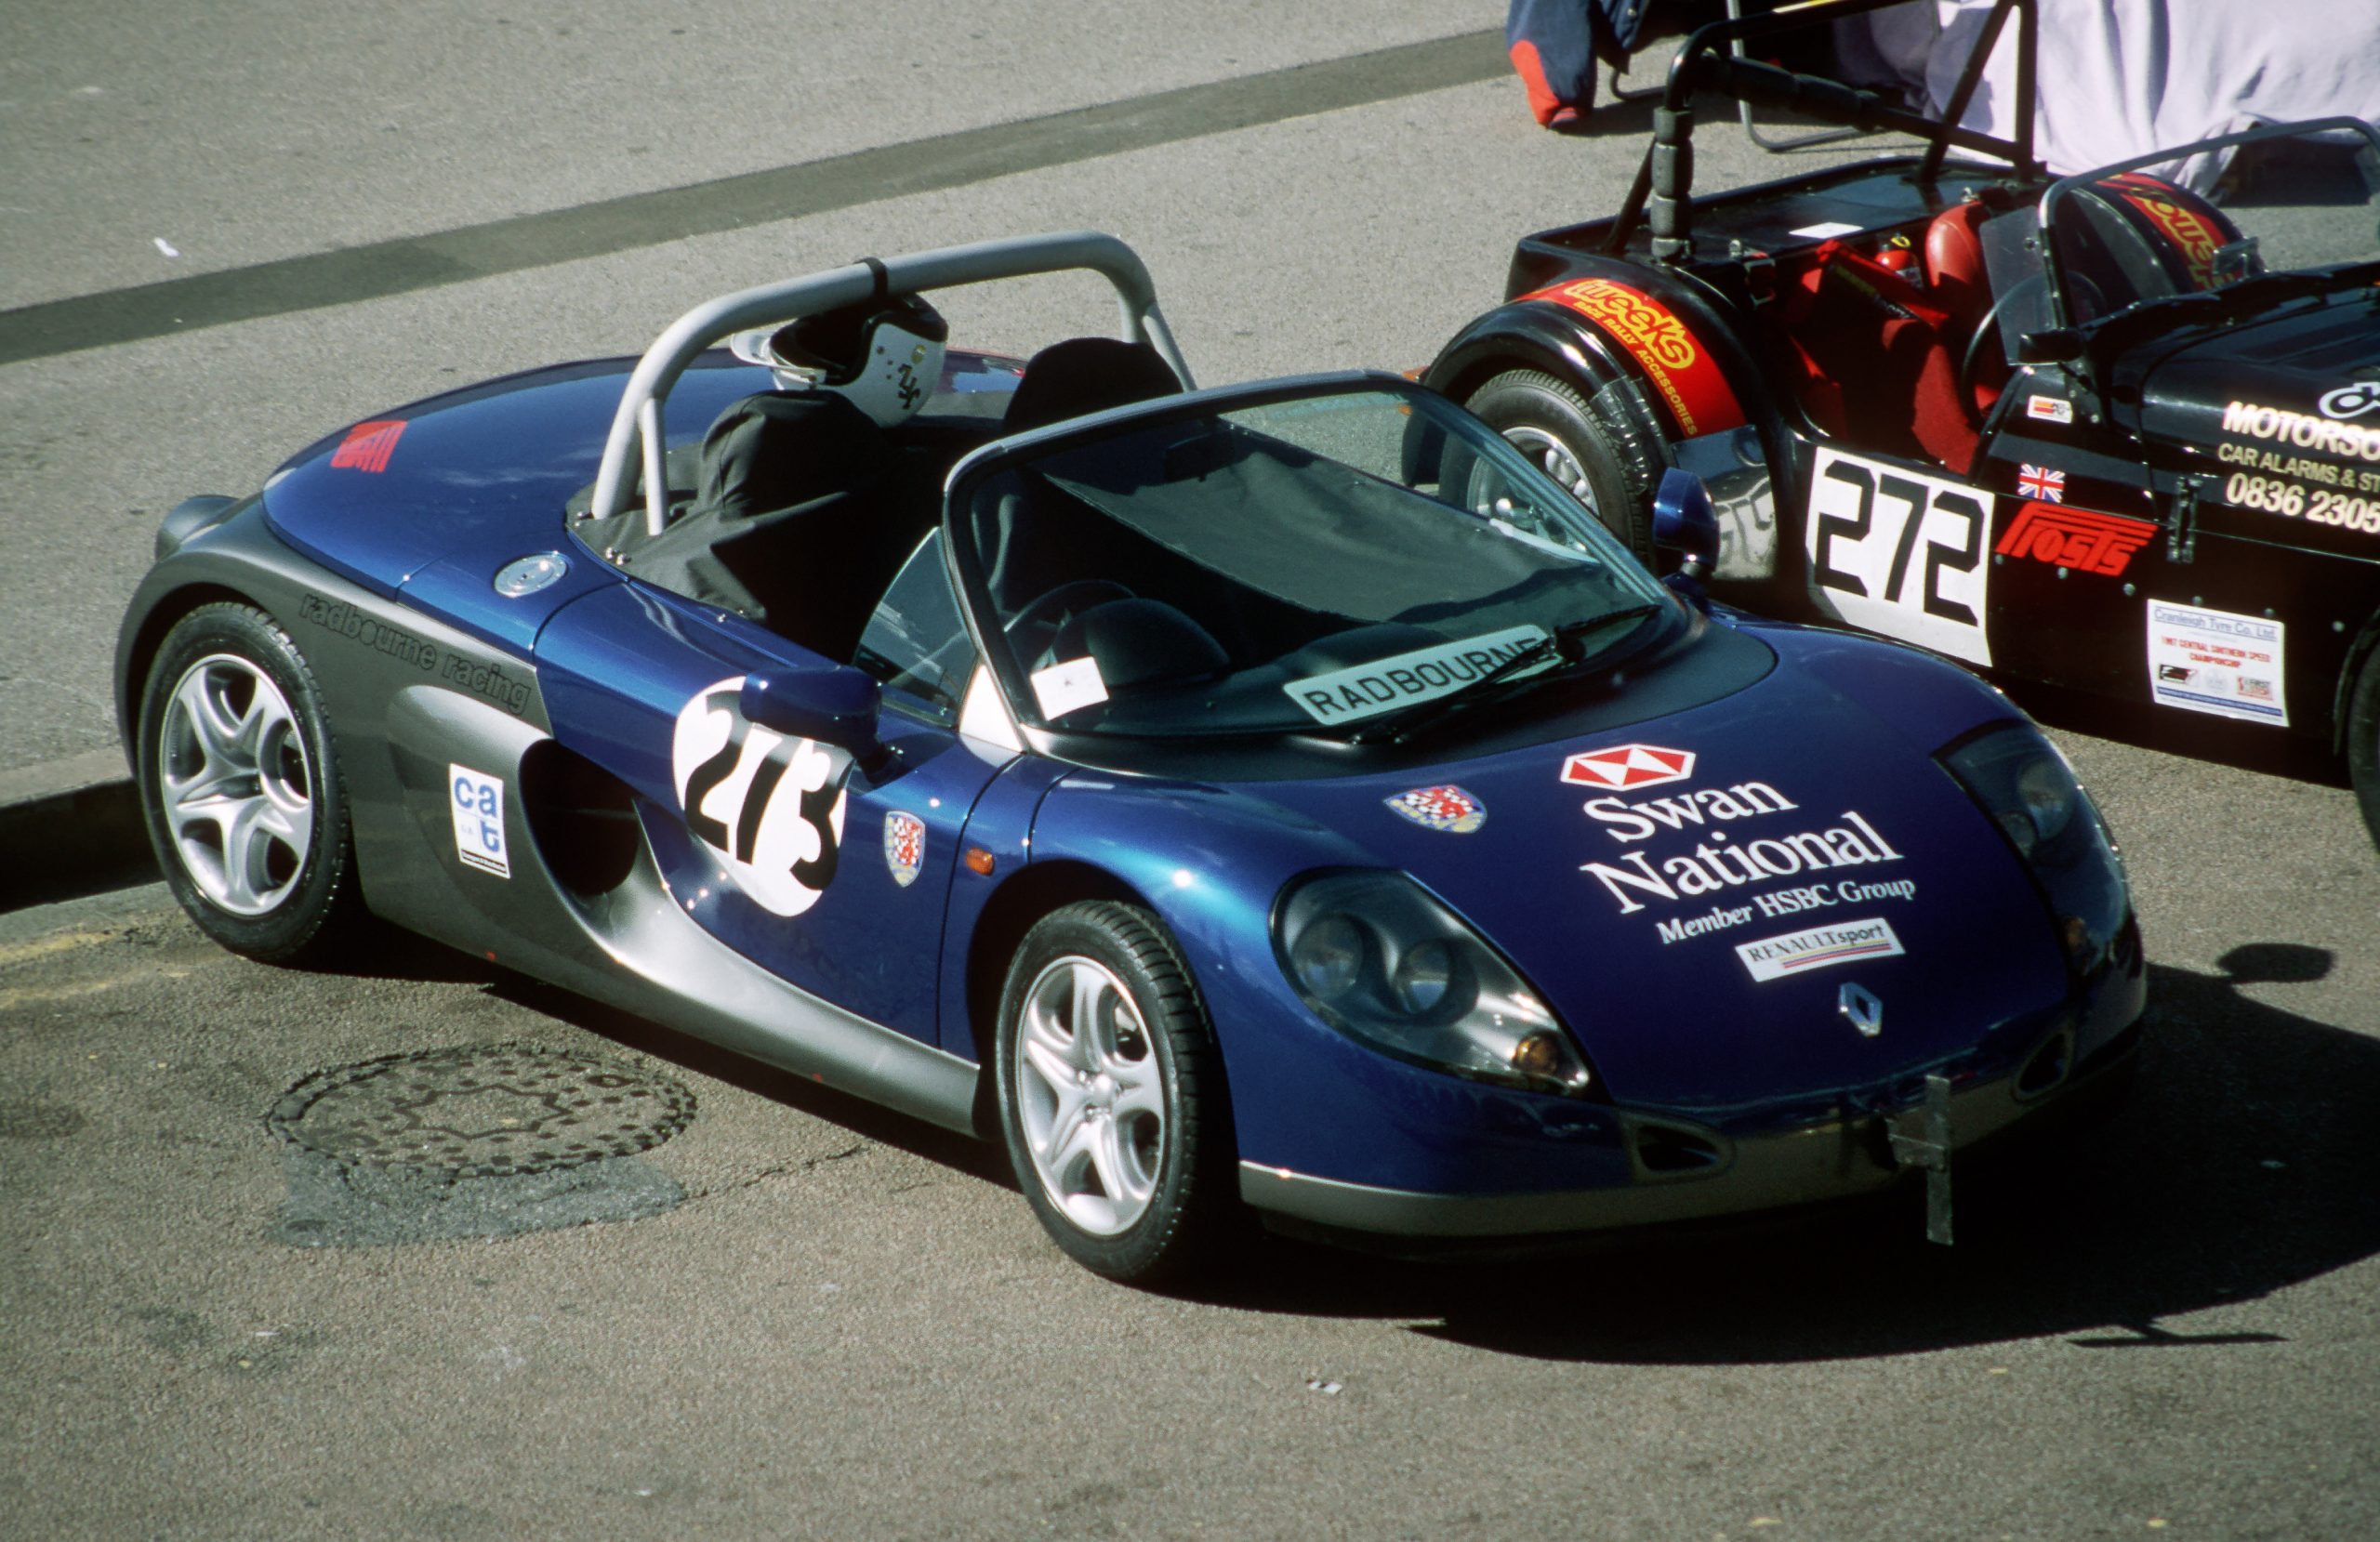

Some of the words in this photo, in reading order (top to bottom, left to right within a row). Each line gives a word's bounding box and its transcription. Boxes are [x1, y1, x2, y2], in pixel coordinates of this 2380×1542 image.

[1603, 318, 1638, 345] RALLY
[1636, 349, 1698, 436] ACCESSORIES
[2218, 443, 2259, 467] CAR
[2259, 452, 2339, 484] ALARMS
[2340, 468, 2356, 488] &
[2223, 401, 2380, 461] MOTORSO
[1815, 459, 1985, 627] 272
[2227, 472, 2305, 516] 0836
[2306, 491, 2380, 534] 2305
[298, 593, 437, 670] radbourne
[442, 653, 531, 716] racing
[684, 690, 846, 890] 273
[1582, 781, 1799, 843] Swan
[1579, 811, 1904, 915] National
[1655, 904, 1752, 945] Member
[1752, 884, 1839, 917] HSBC
[1837, 879, 1916, 903] Group
